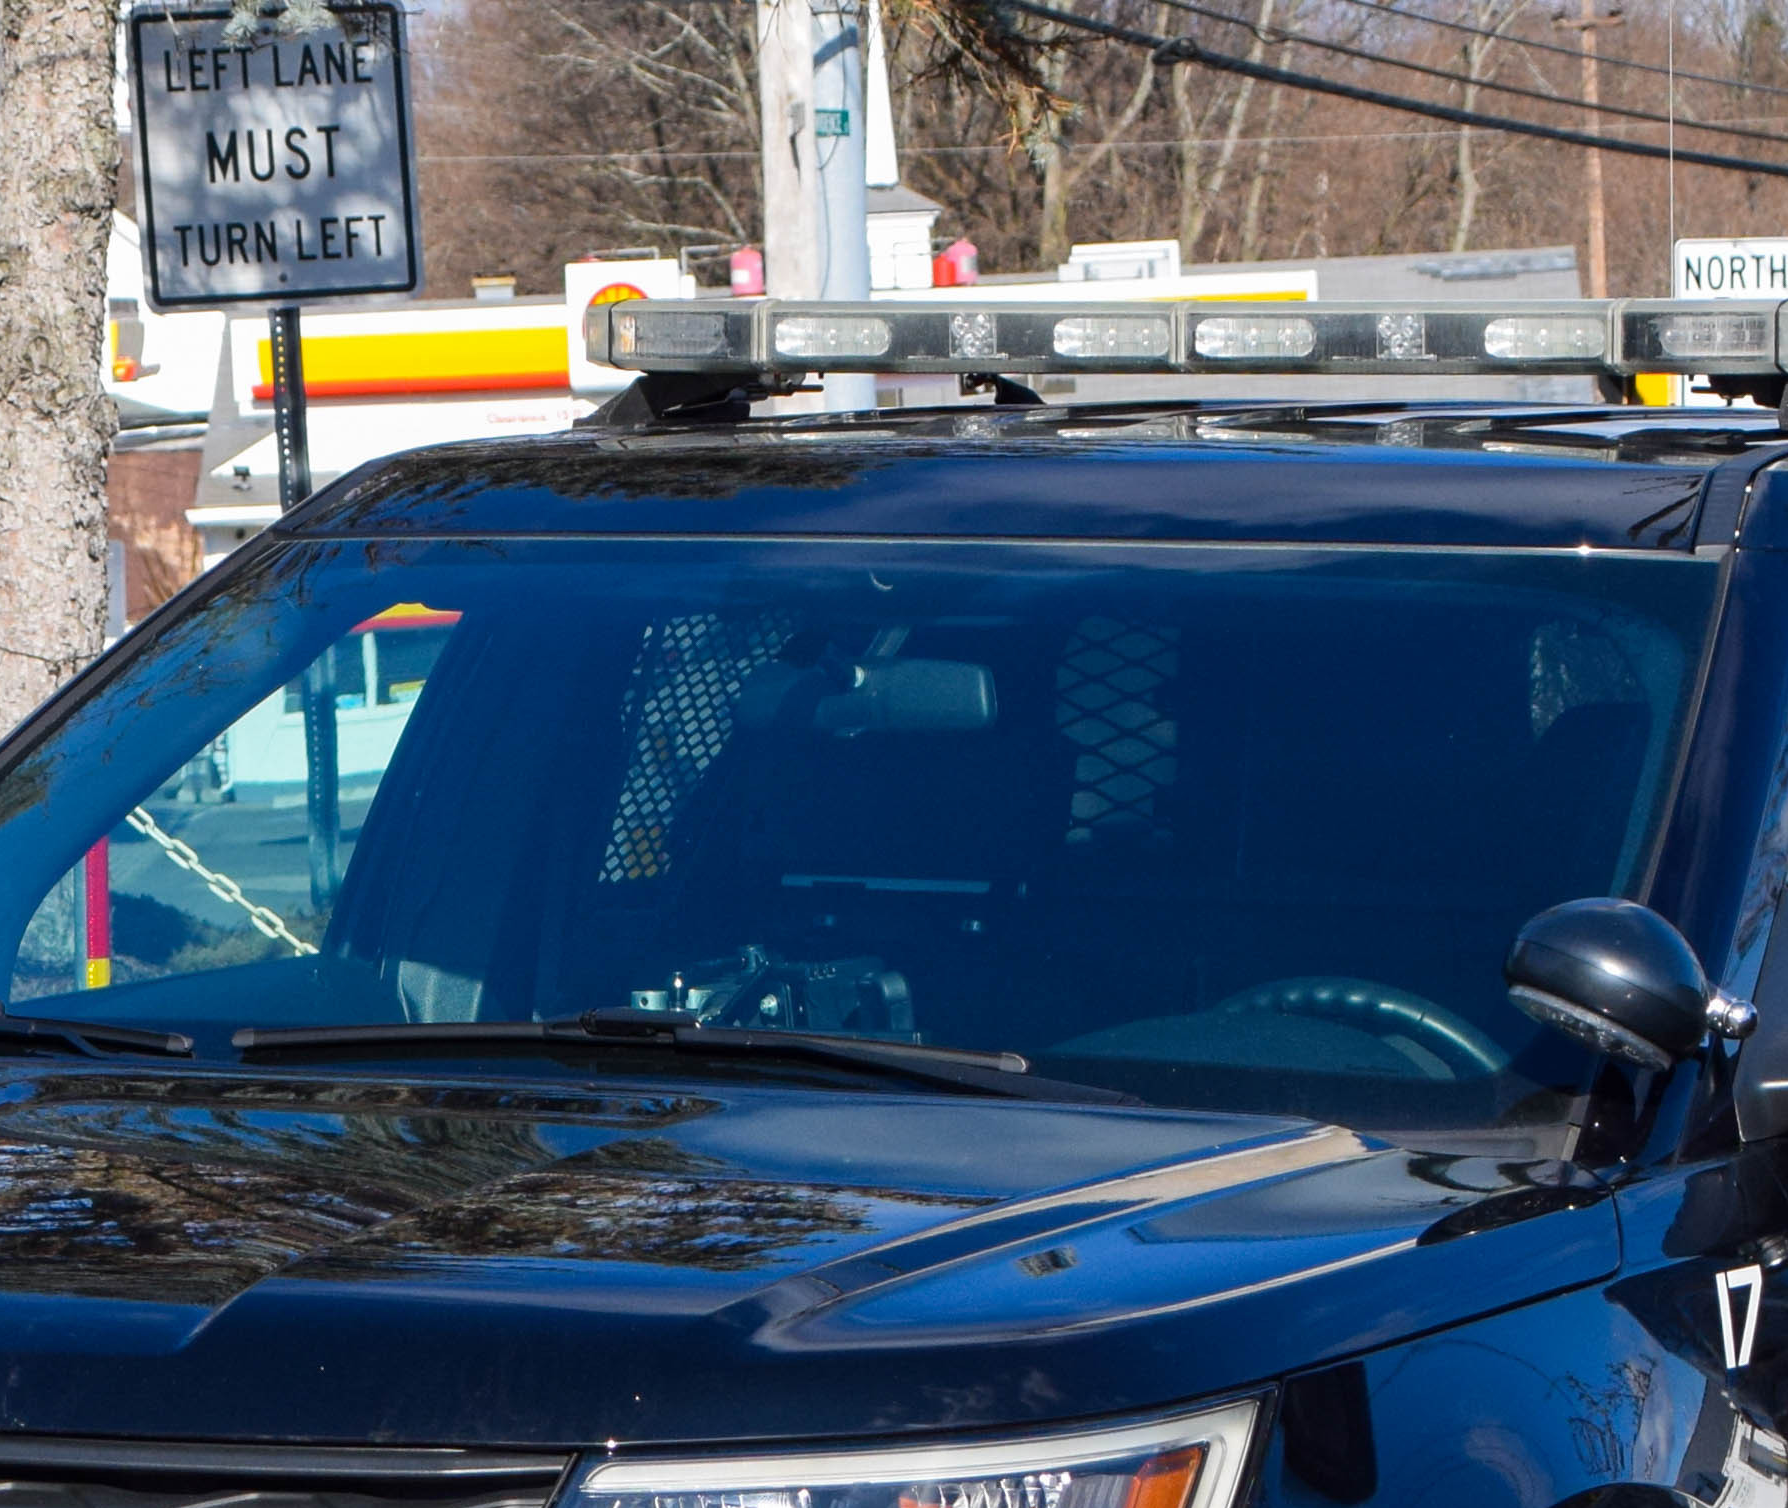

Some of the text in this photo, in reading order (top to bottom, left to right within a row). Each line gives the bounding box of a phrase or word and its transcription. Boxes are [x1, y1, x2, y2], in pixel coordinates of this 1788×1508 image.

[164, 40, 374, 92] LEFT LANE
[206, 125, 341, 183] MUST
[173, 215, 387, 267] TURN LEFT
[1685, 253, 1787, 290] NORTH
[1715, 1263, 1762, 1369] 17
